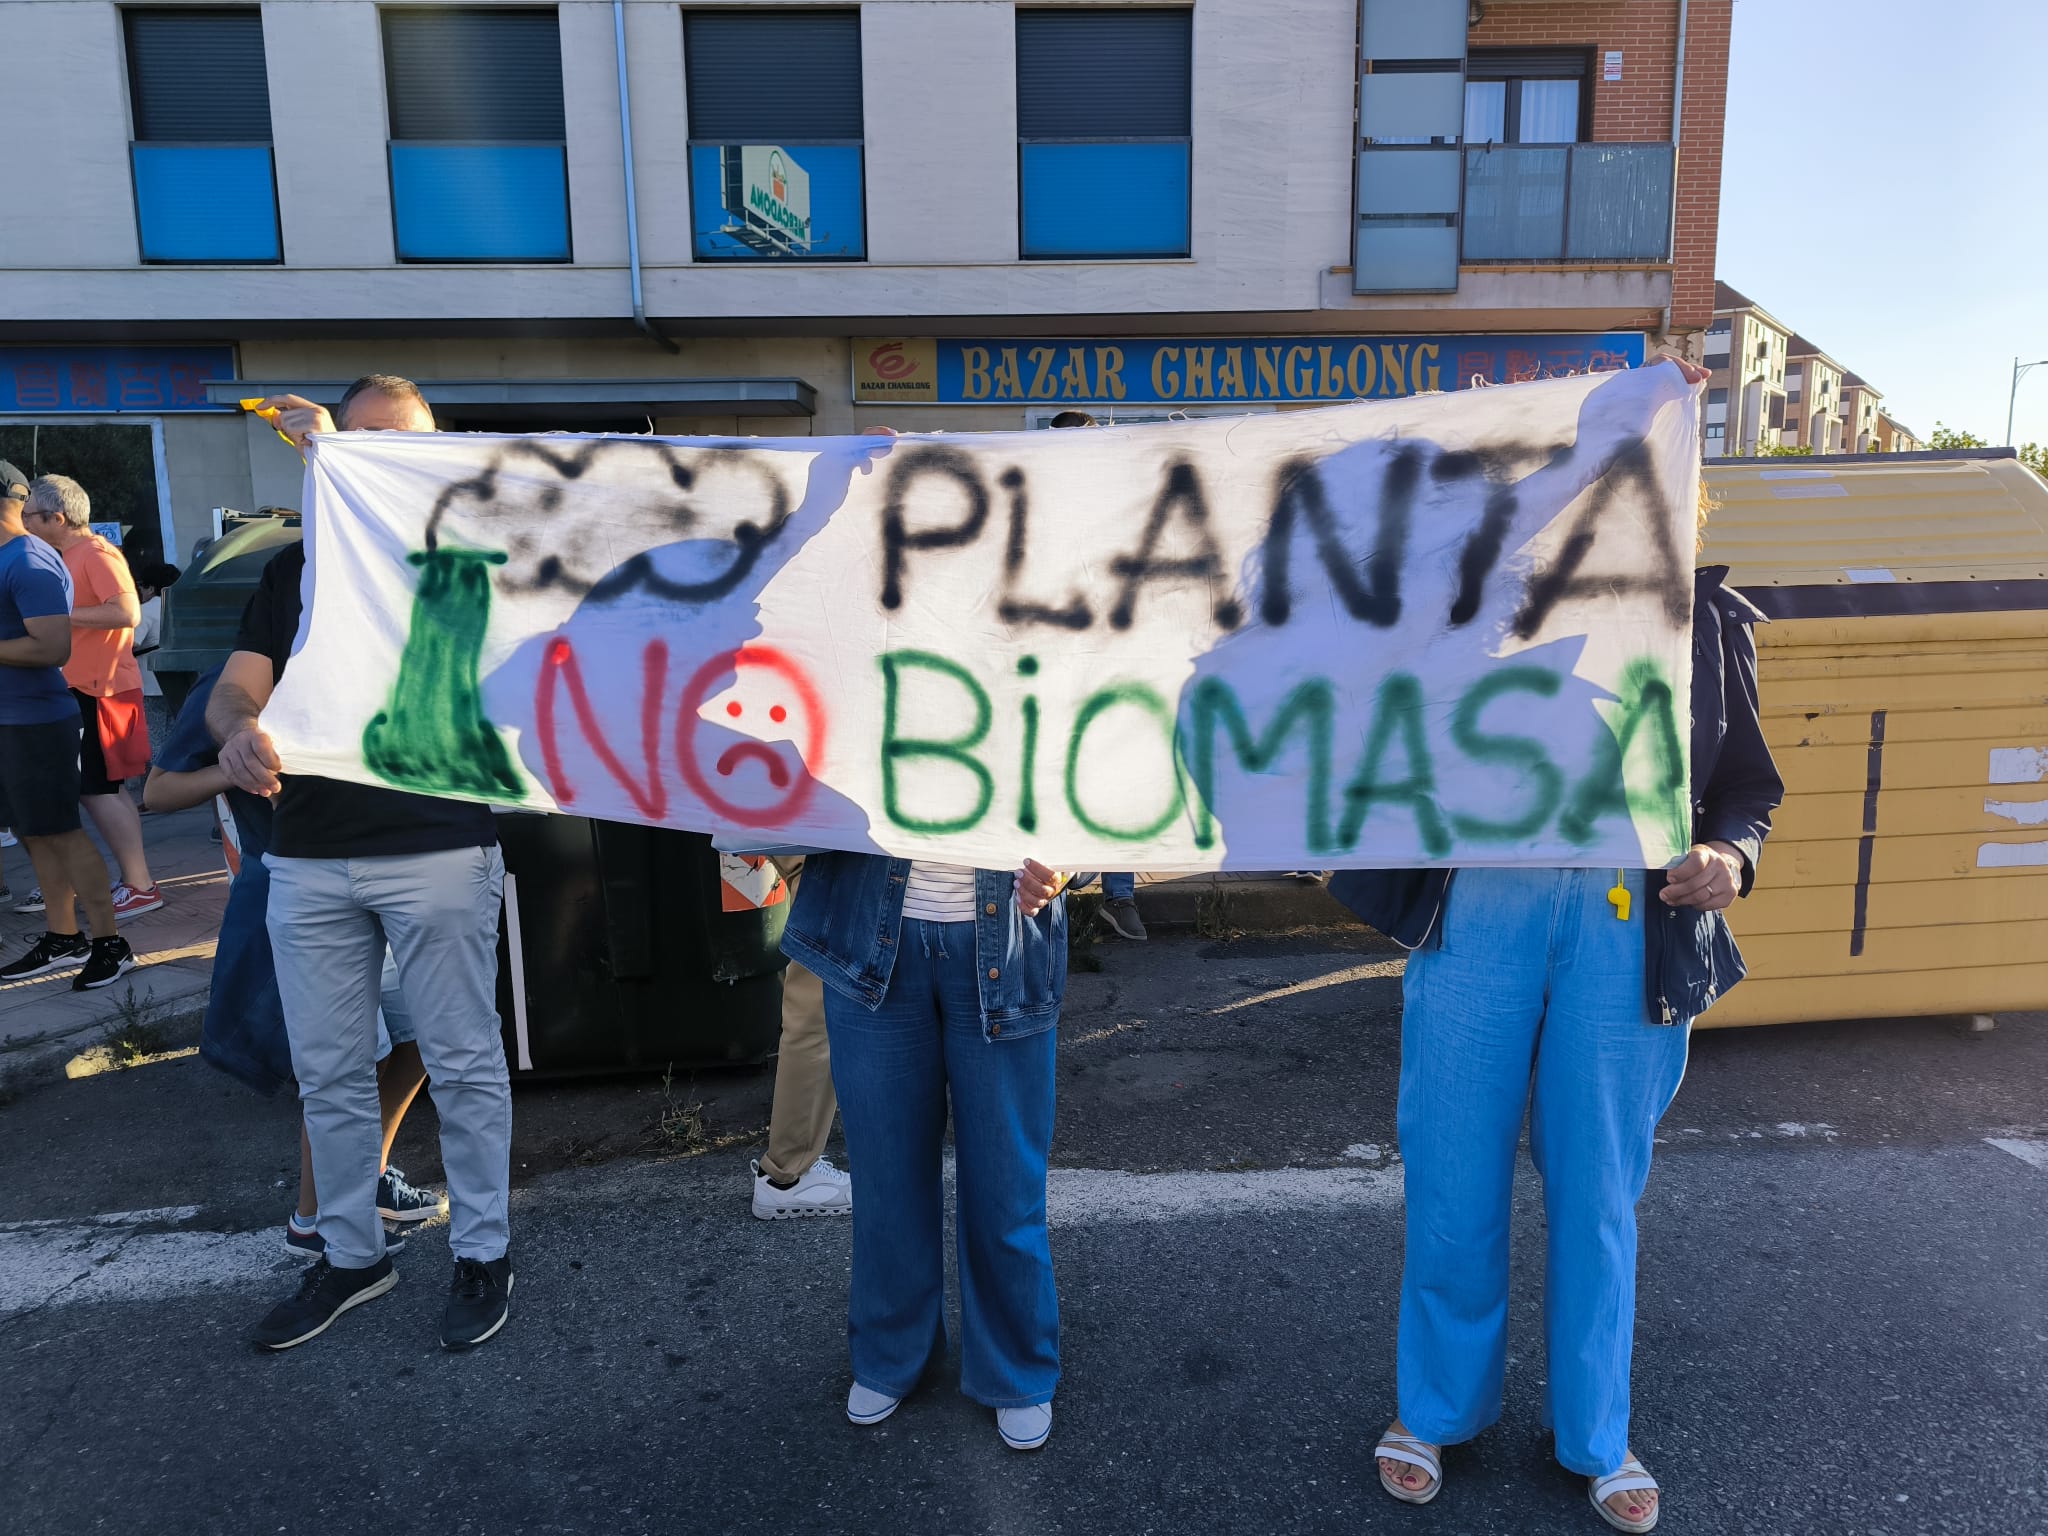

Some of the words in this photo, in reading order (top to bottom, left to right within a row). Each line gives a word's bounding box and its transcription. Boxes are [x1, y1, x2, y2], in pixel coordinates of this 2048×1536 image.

[861, 382, 886, 390] BAZAR
[887, 381, 931, 390] CHANGLONG
[961, 345, 1127, 400] BAZAR
[1151, 343, 1441, 400] CHANGLONG
[879, 437, 1692, 639] PLANTA
[535, 635, 827, 829] NO
